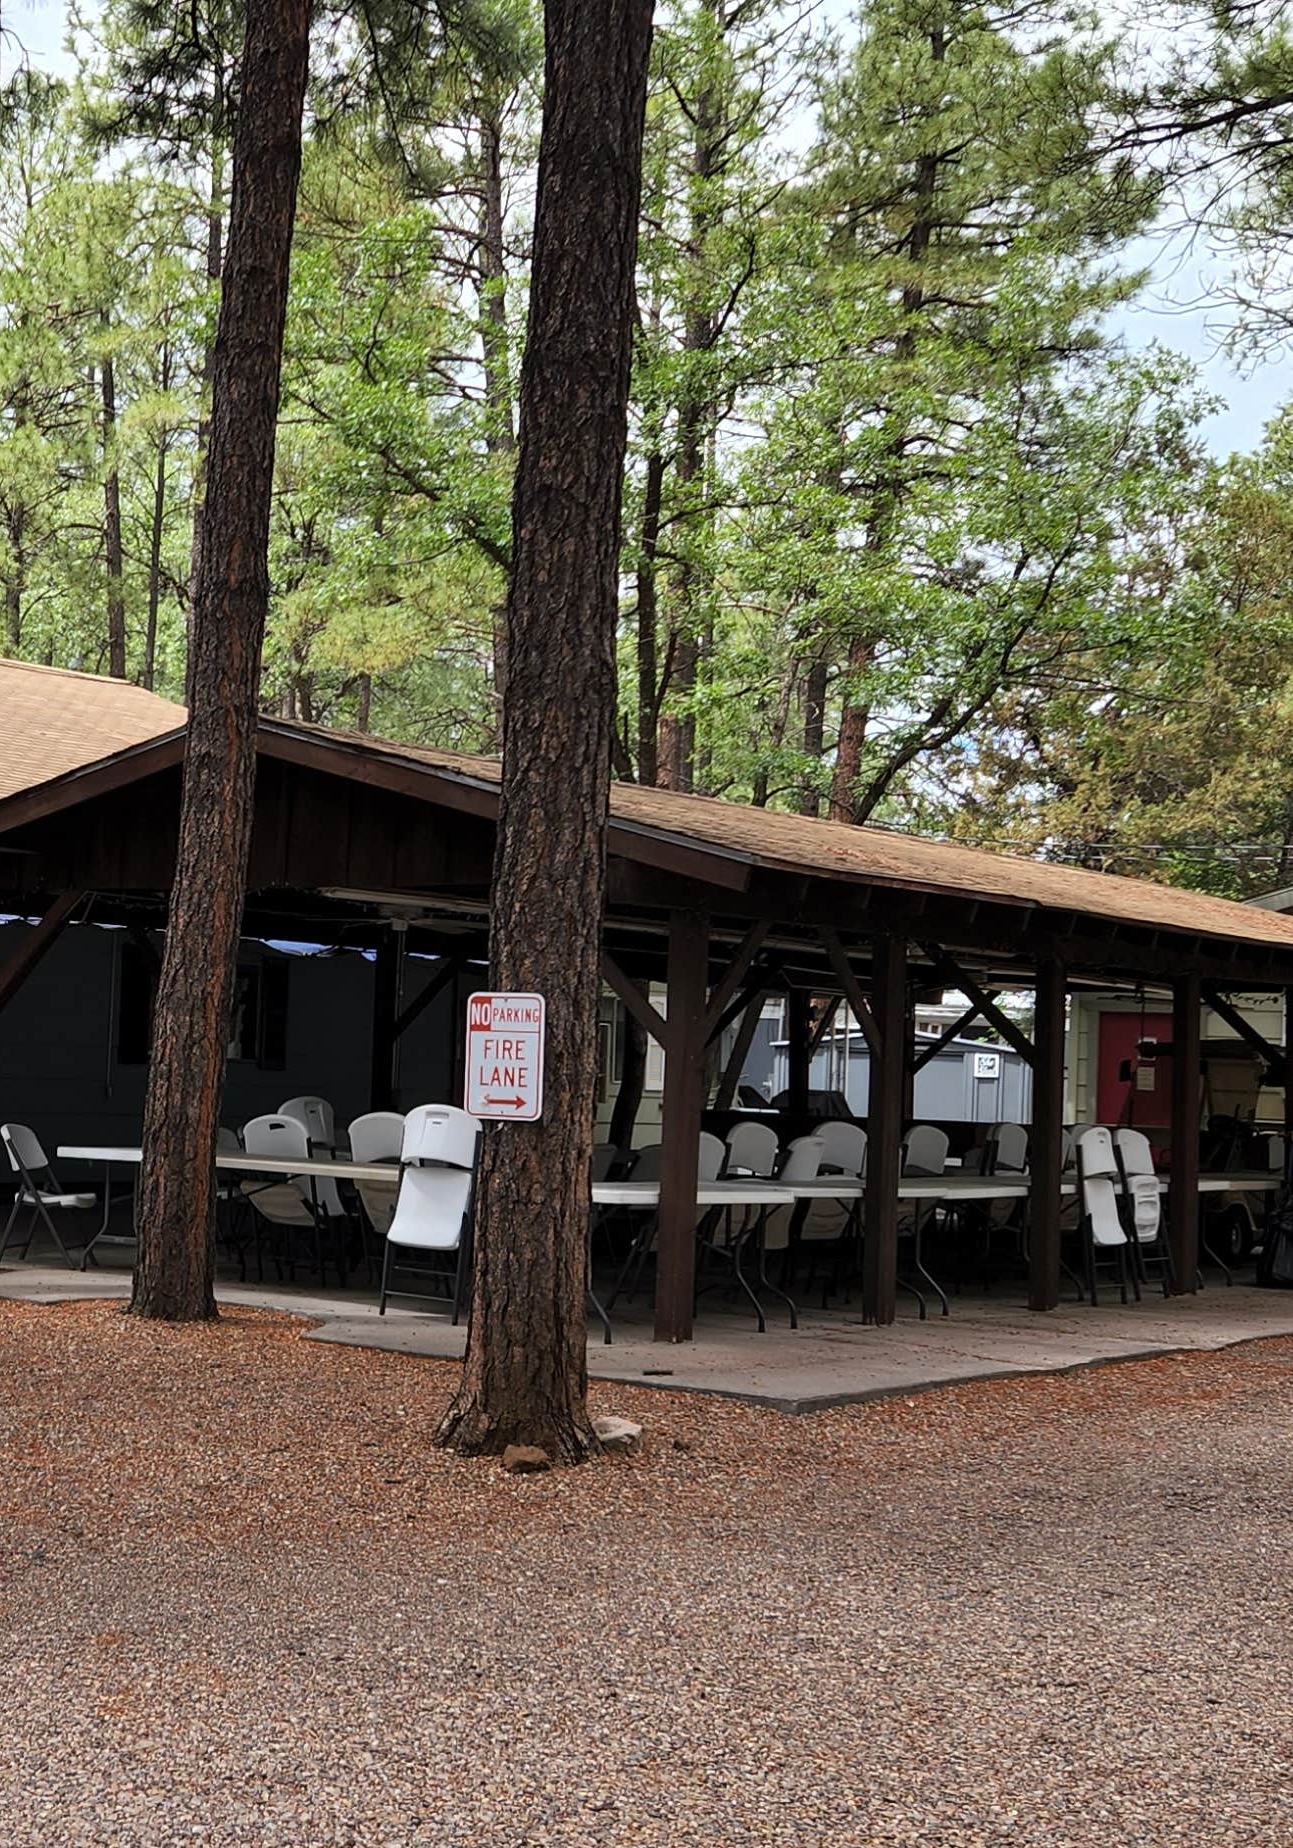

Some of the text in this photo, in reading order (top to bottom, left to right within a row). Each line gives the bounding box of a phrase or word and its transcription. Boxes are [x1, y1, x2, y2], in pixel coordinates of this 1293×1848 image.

[471, 1002, 540, 1026] NO PARKING
[483, 1039, 526, 1060] FIRE
[479, 1066, 529, 1088] LANE
